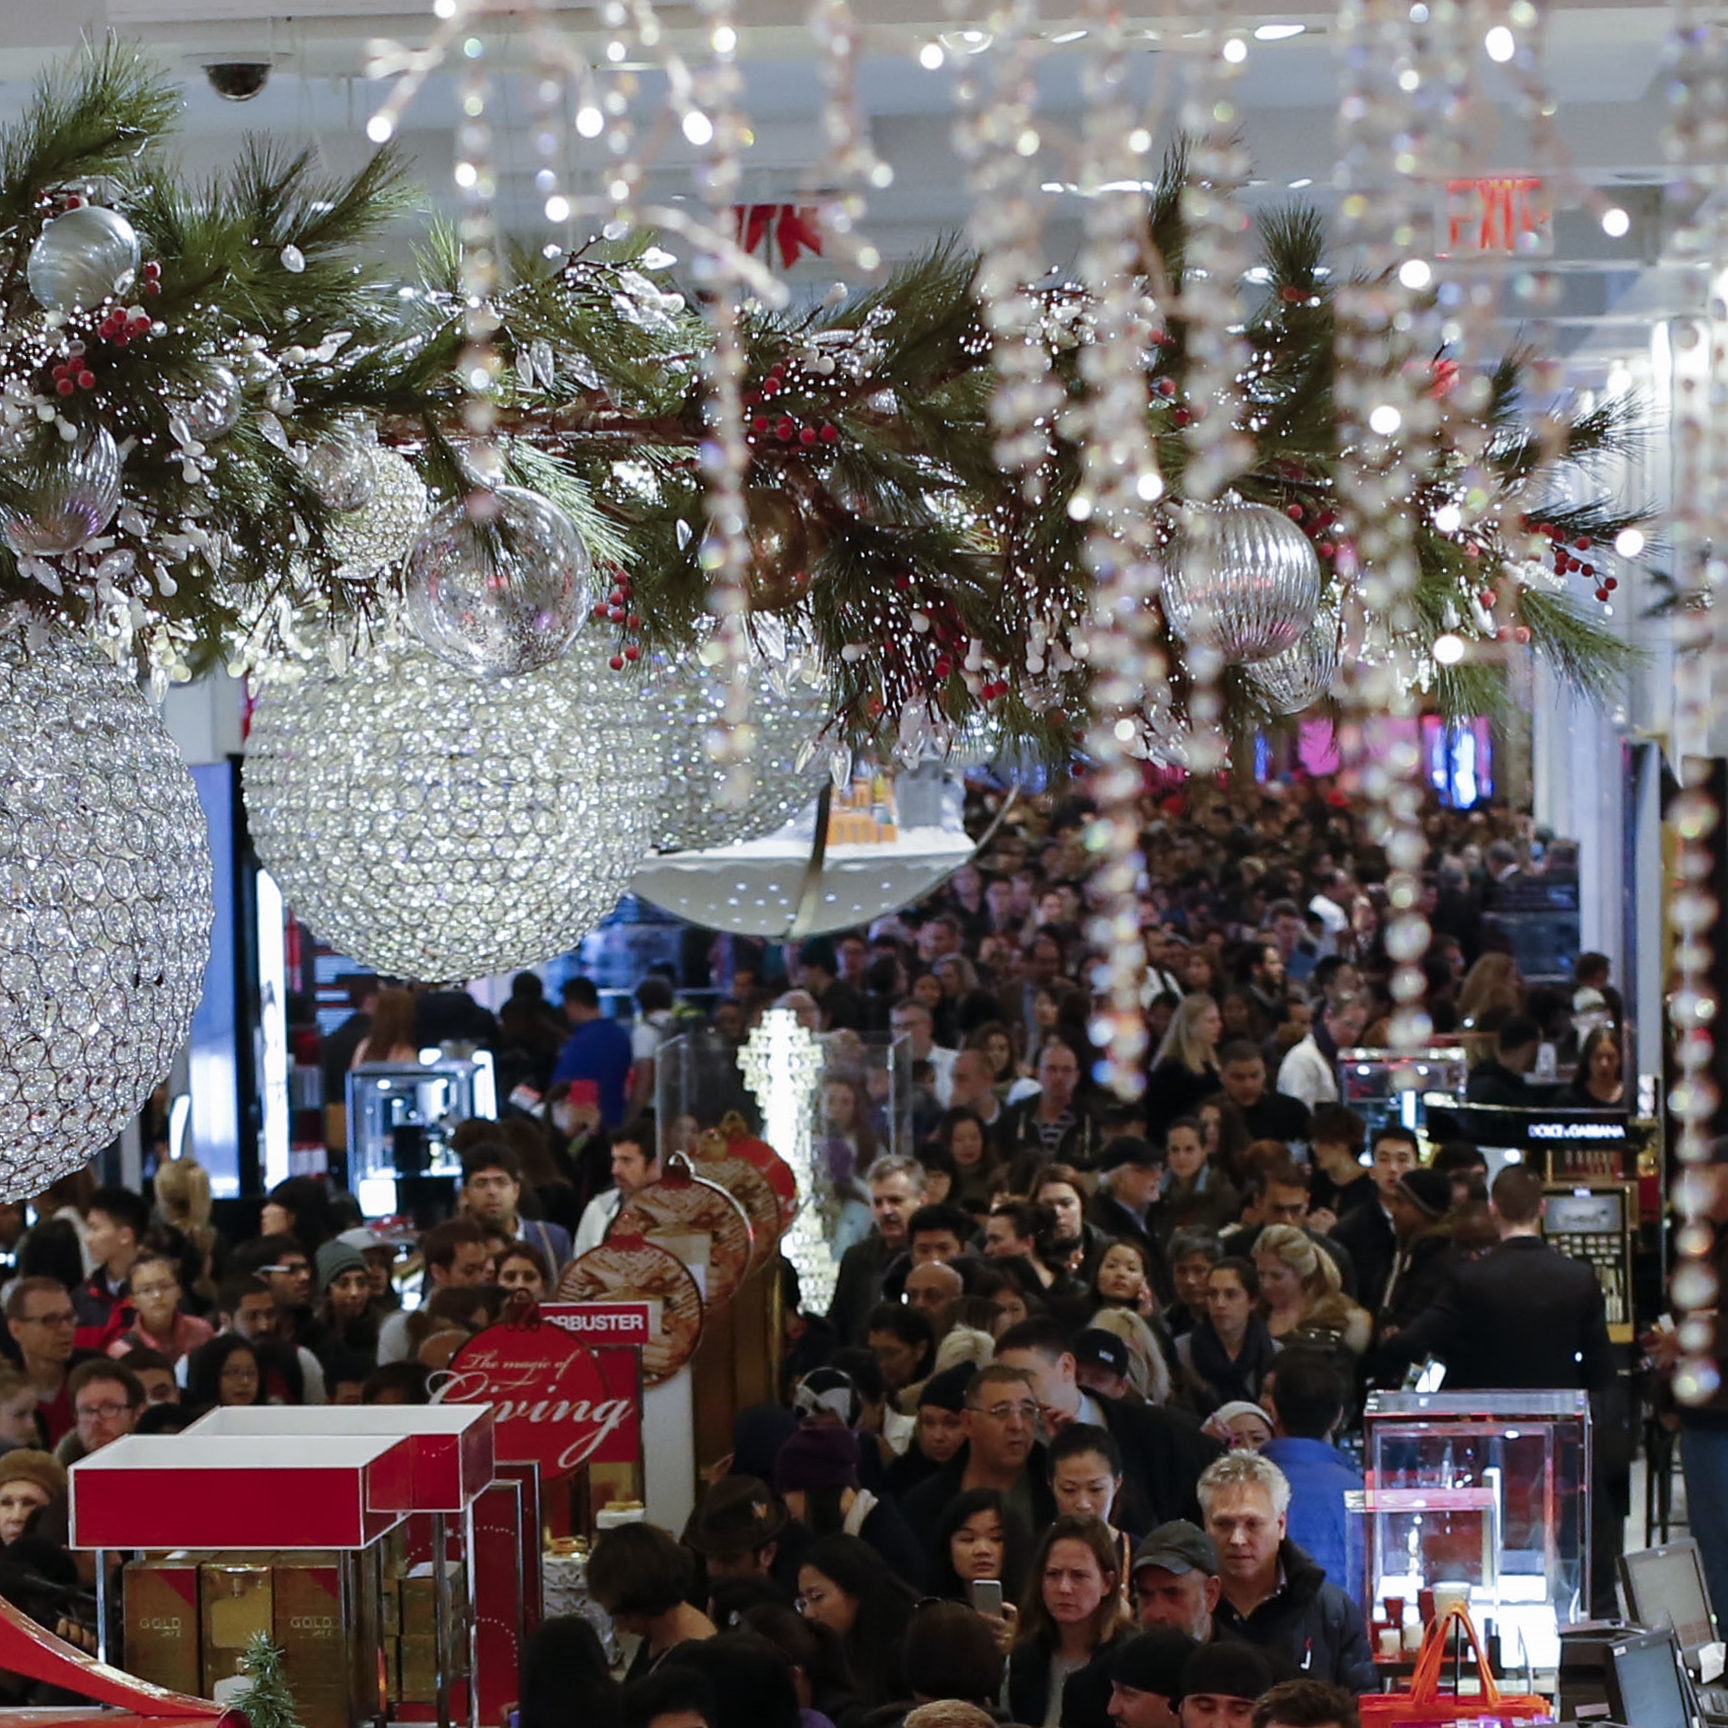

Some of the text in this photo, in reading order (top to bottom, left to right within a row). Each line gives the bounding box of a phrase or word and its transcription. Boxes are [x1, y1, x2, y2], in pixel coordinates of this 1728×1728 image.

[553, 1349, 581, 1380] of
[140, 1617, 182, 1630] GOLD
[290, 1616, 332, 1629] GOLD
